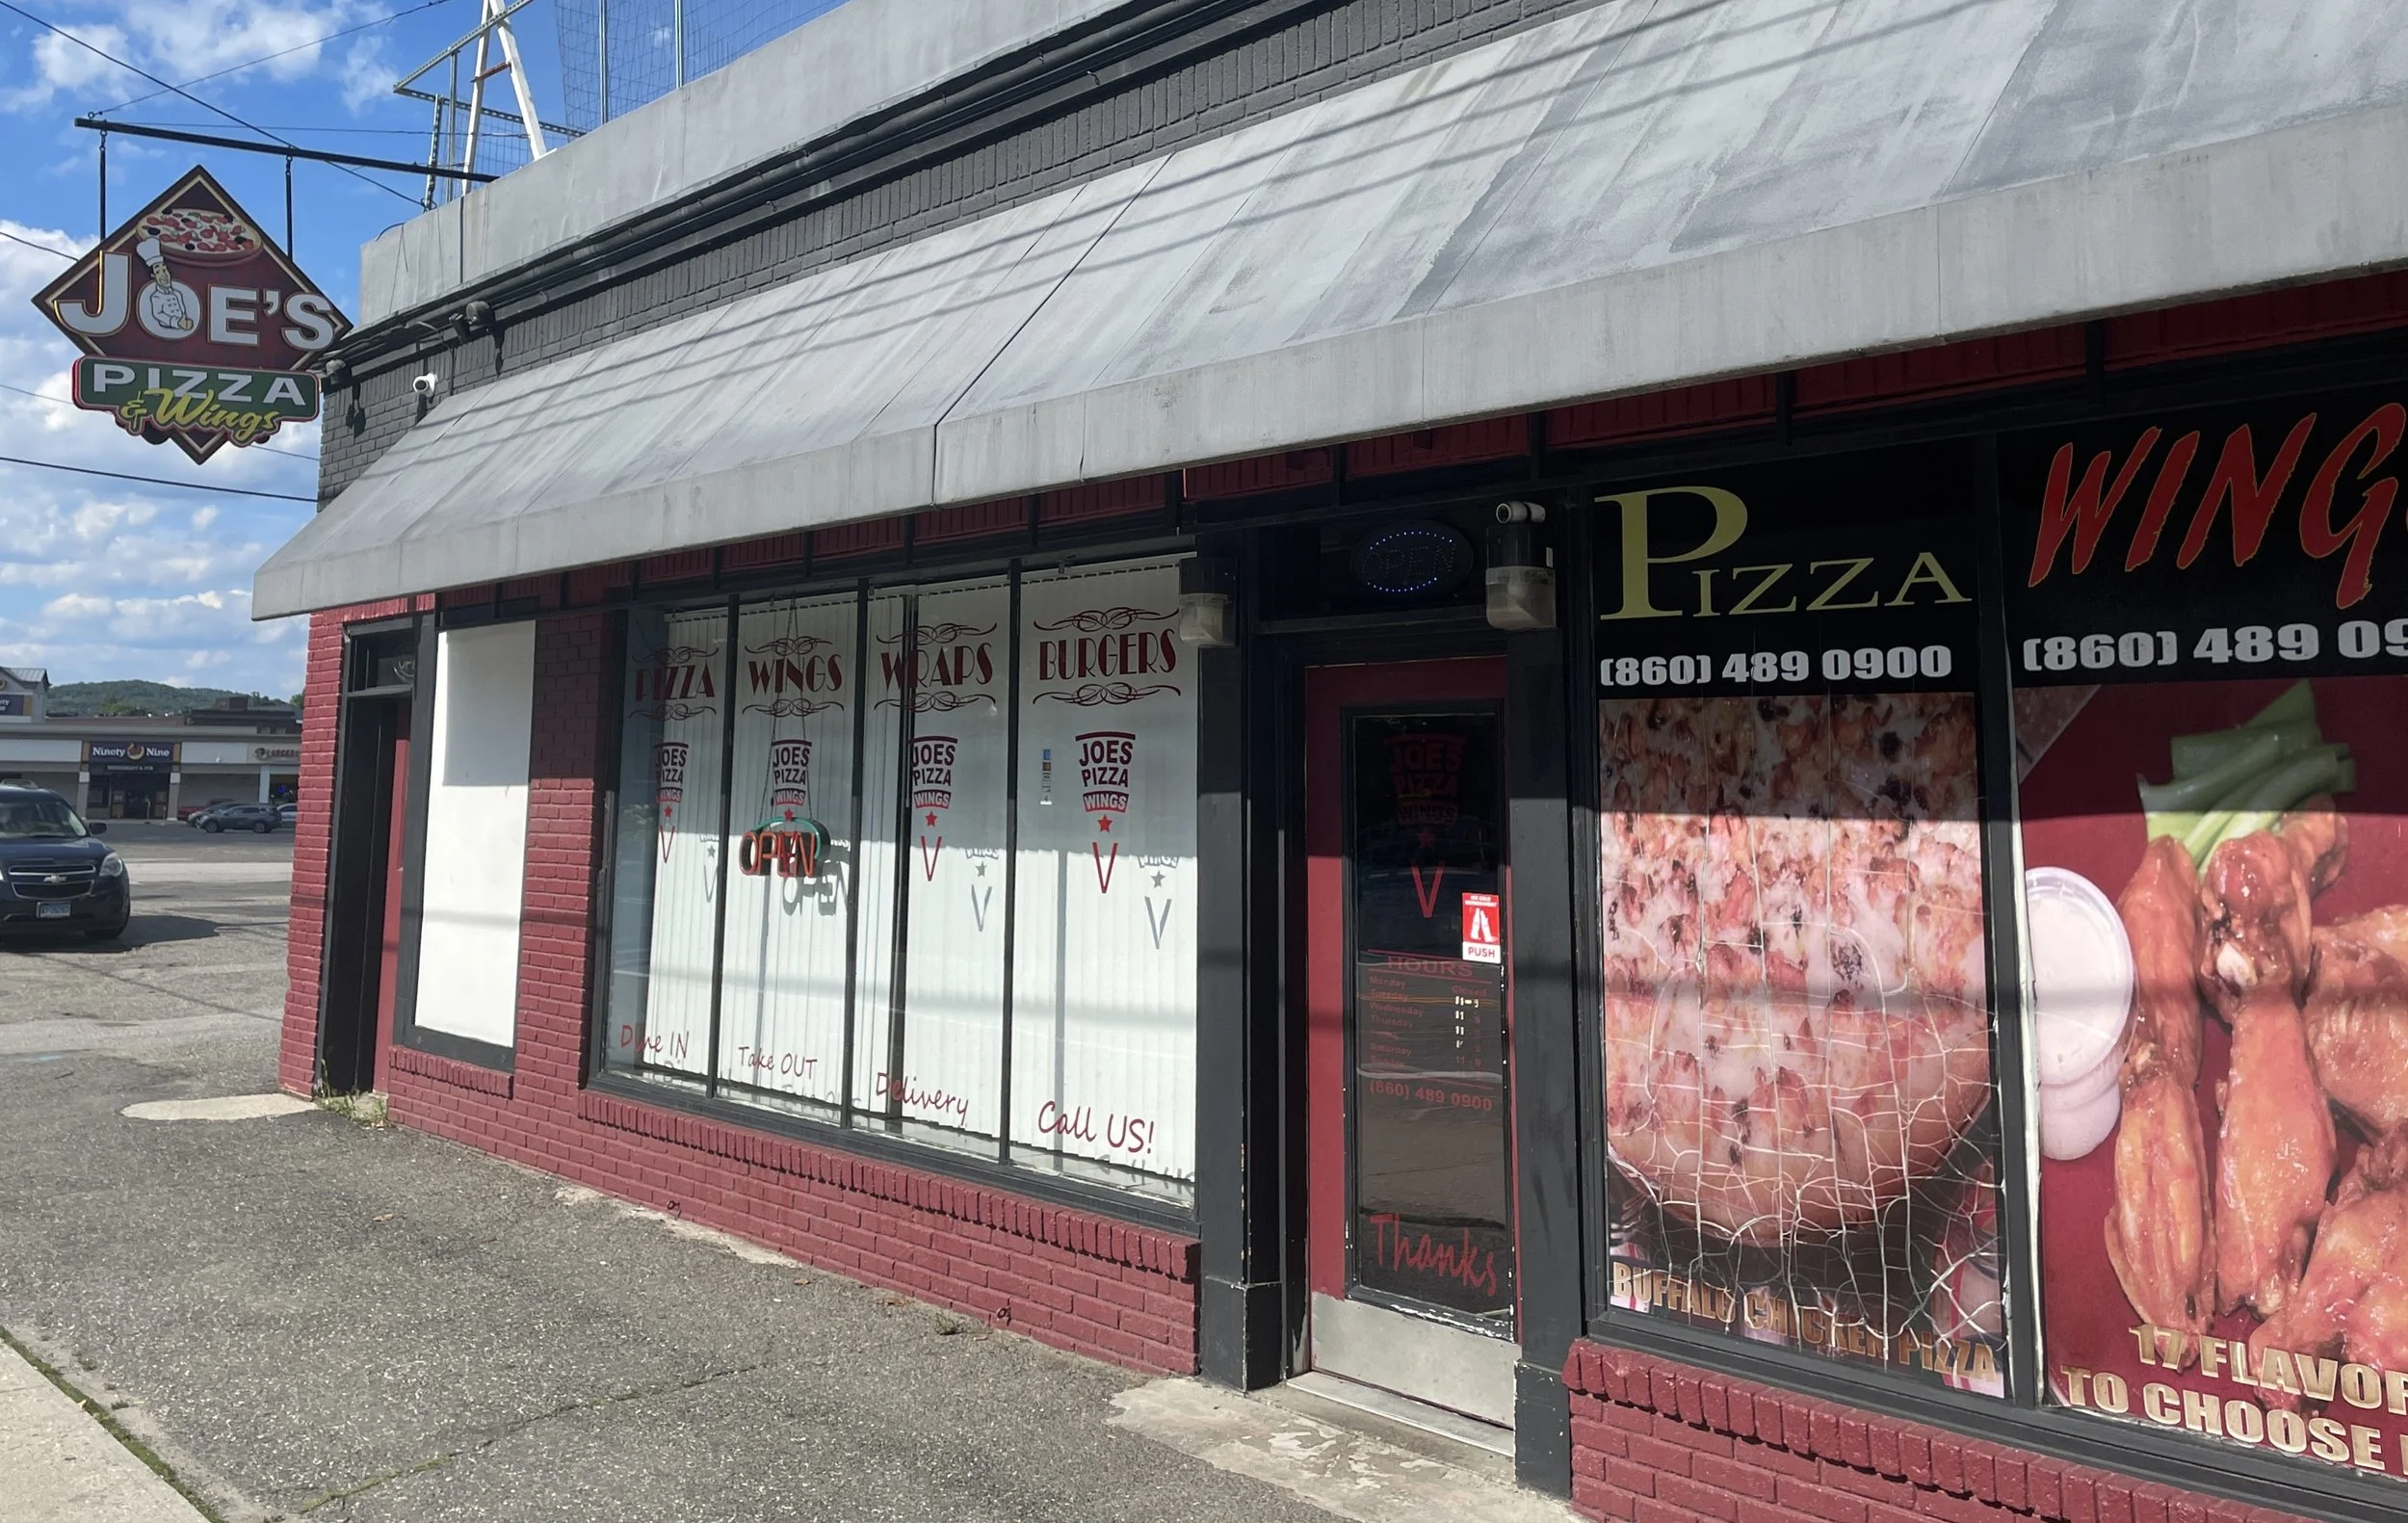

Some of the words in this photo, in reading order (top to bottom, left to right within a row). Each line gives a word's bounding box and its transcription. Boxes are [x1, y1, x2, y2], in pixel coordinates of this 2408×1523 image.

[54, 249, 334, 351] JOE'S
[93, 363, 306, 407] PIZZA
[145, 387, 280, 439] Wings
[2028, 403, 2408, 610] WING
[1038, 628, 1177, 680] BURGERS
[2192, 623, 2319, 664] 489
[635, 662, 715, 701] PIZZA
[748, 654, 843, 696] WINGS
[880, 642, 993, 692] WRAPS
[1722, 651, 1809, 683] 489
[1822, 644, 1951, 680] 0900
[92, 747, 126, 758] Ninety
[145, 748, 170, 757] Nine
[655, 748, 687, 768] JOES
[772, 747, 810, 767] JOES
[912, 743, 955, 767] JOES
[1079, 741, 1134, 767] JOES
[774, 769, 806, 785] PIZZA
[913, 769, 952, 787] PIZZA
[1082, 767, 1129, 788] PIZZA
[774, 789, 805, 805] WINGS
[914, 790, 951, 808] WINGS
[1084, 792, 1128, 812] WINGS
[739, 831, 816, 878] OPEN
[1387, 955, 1474, 978] HOURS
[1468, 946, 1496, 958] PUSH
[1370, 976, 1406, 989] Monday
[670, 1031, 689, 1059] IN
[738, 1045, 774, 1071] Take
[781, 1052, 818, 1079] OUT
[876, 1071, 969, 1128] Delivery
[1369, 1079, 1410, 1100] (860)
[1414, 1086, 1445, 1104] 489
[1451, 1092, 1492, 1112] 0900
[1037, 1100, 1096, 1142] Call
[1107, 1112, 1155, 1154] US!
[1370, 1211, 1497, 1297] Thanks
[1612, 1261, 1737, 1324] BUFFALO
[1898, 1328, 1998, 1382] PIZZA
[2129, 1323, 2187, 1372] 17
[2061, 1364, 2130, 1414] TO
[2142, 1381, 2386, 1472] CHOOSE
